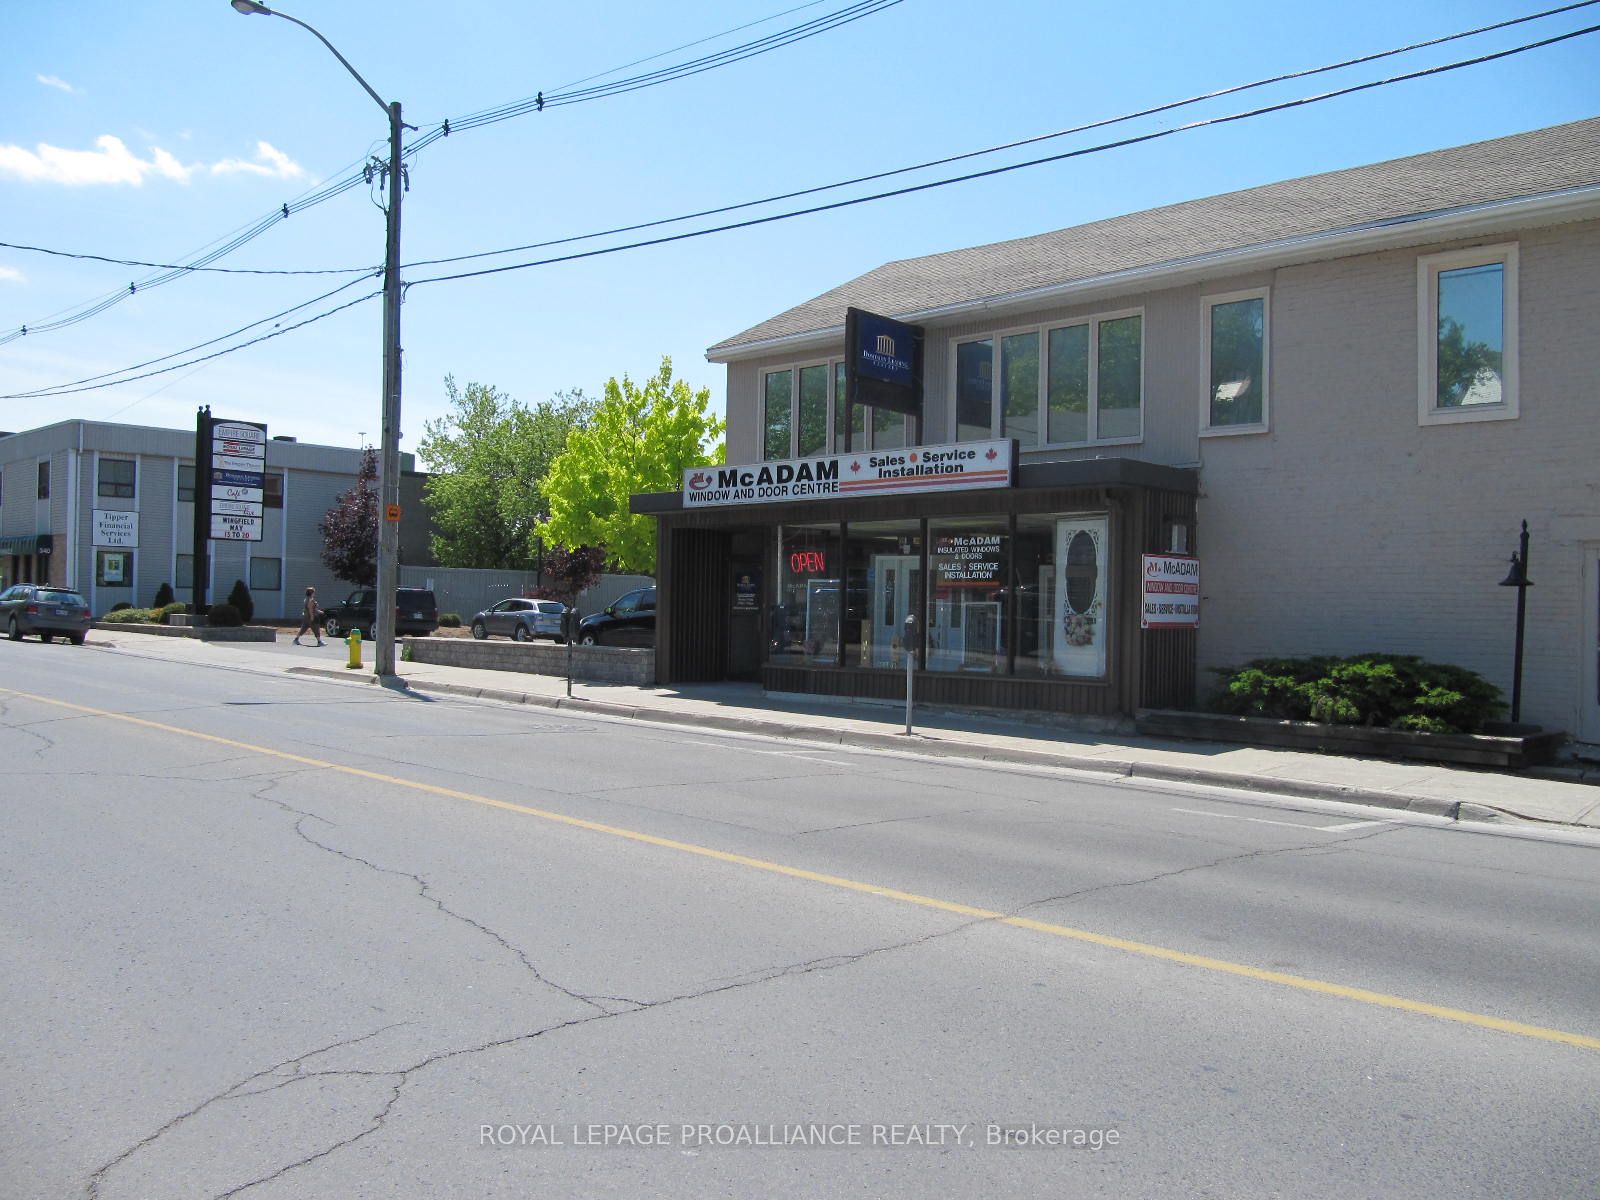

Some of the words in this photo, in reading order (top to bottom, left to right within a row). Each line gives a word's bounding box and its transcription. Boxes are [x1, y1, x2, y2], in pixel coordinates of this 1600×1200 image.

[870, 456, 906, 468] Sales
[922, 450, 976, 463] Service
[718, 460, 838, 488] McADAM
[878, 463, 964, 478] Installation
[689, 490, 730, 502] WINDOW
[734, 488, 754, 500] AND
[758, 486, 788, 498] DOOR
[792, 482, 838, 494] CENTRE
[104, 512, 128, 521] Tipper
[223, 517, 254, 525] WINGFIELD
[954, 536, 1000, 546] McADAM
[792, 552, 825, 573] OPEN
[1164, 561, 1198, 576] McADAM
